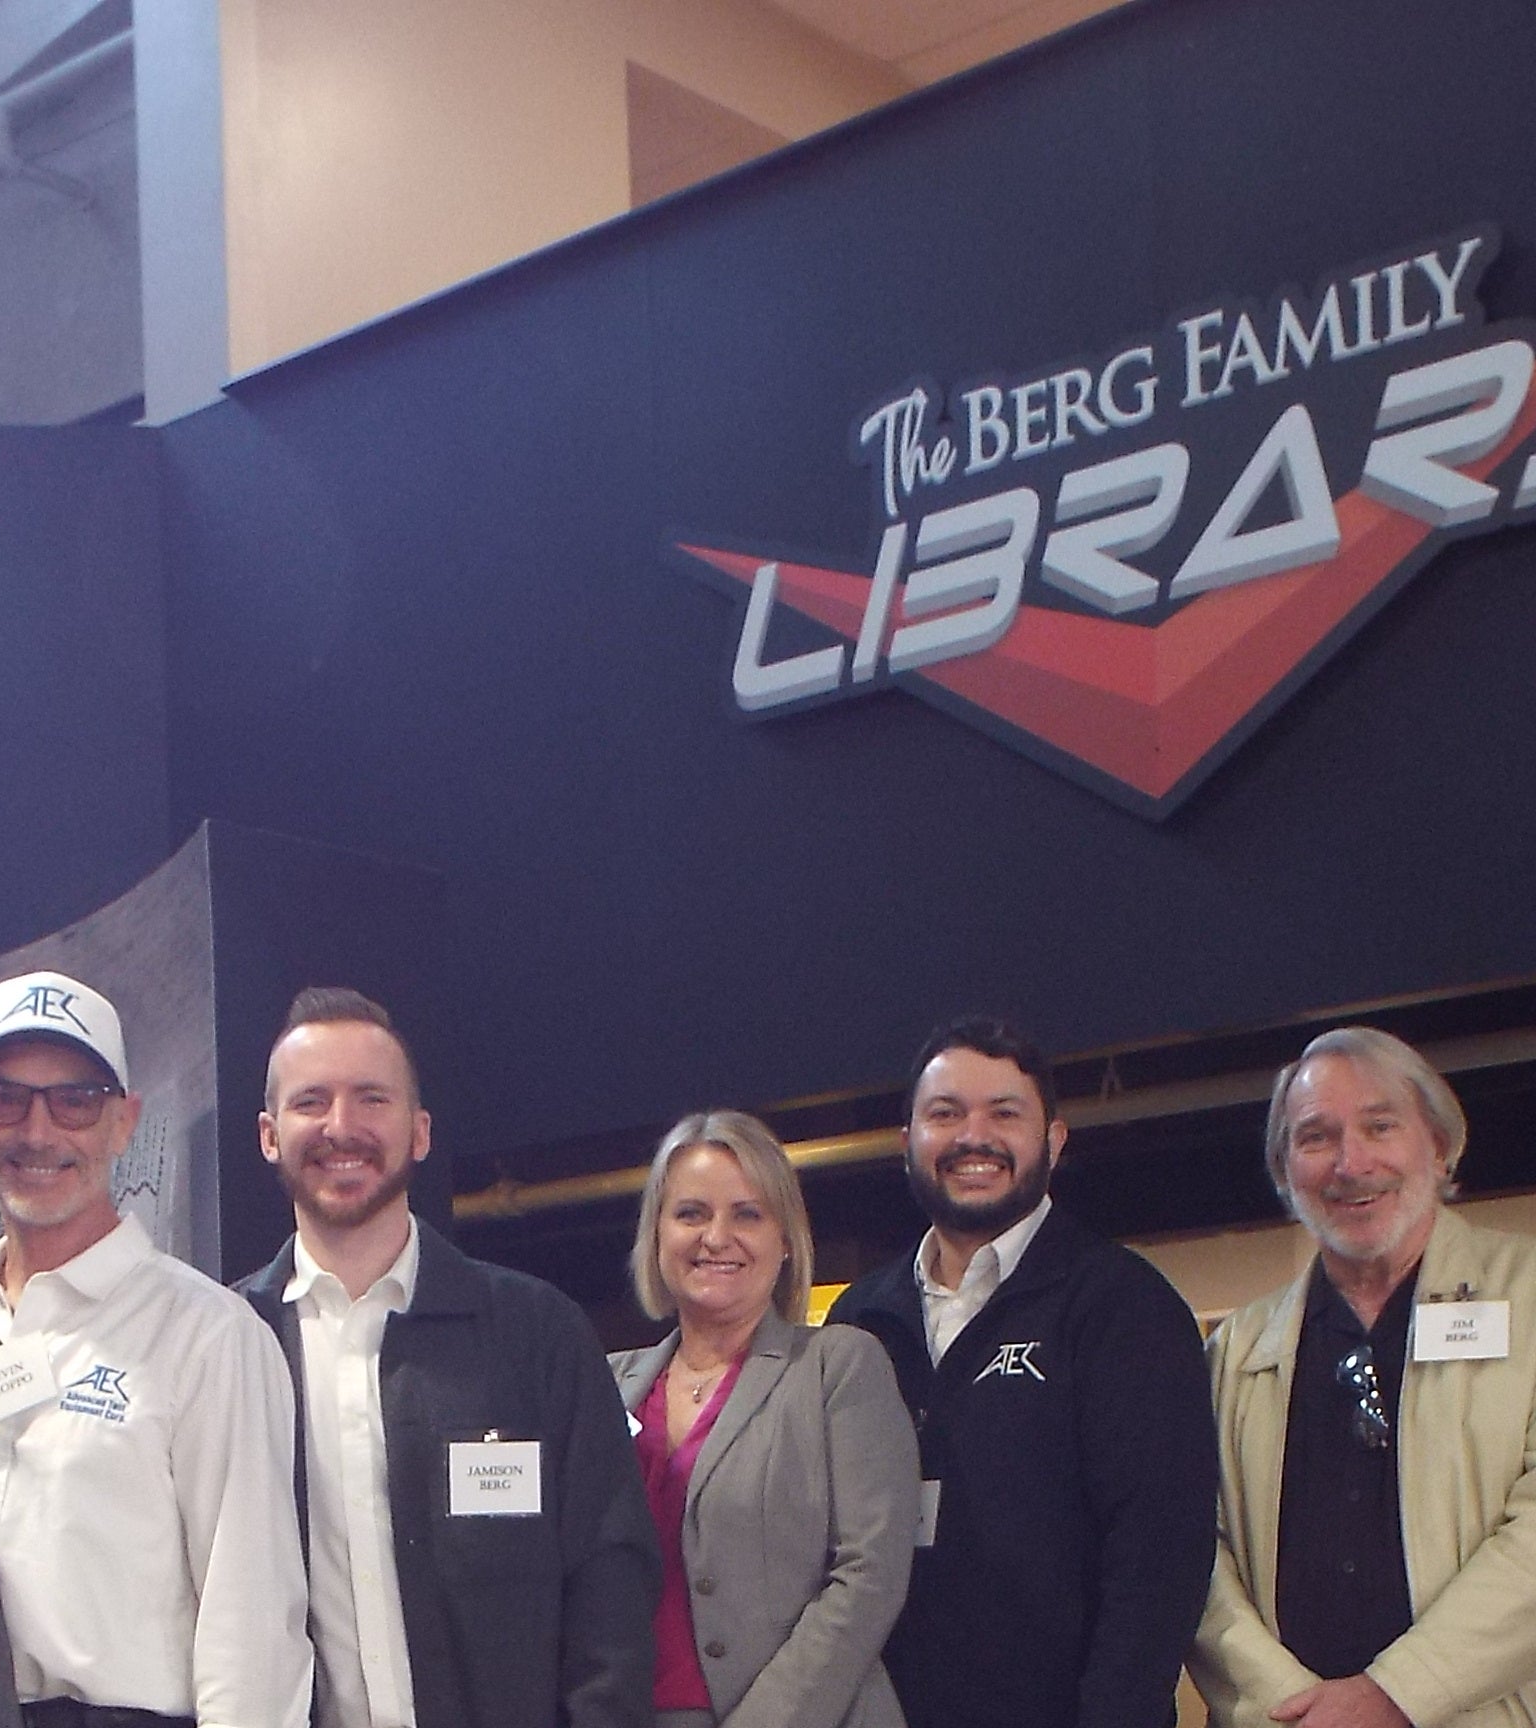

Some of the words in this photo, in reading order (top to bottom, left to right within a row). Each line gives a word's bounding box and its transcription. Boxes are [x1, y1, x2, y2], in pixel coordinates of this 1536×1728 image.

[861, 386, 957, 516] The
[962, 345, 1159, 477] BERG
[1175, 238, 1482, 410] FAMILY
[467, 1465, 523, 1476] JAMISON
[479, 1480, 511, 1490] BERG
